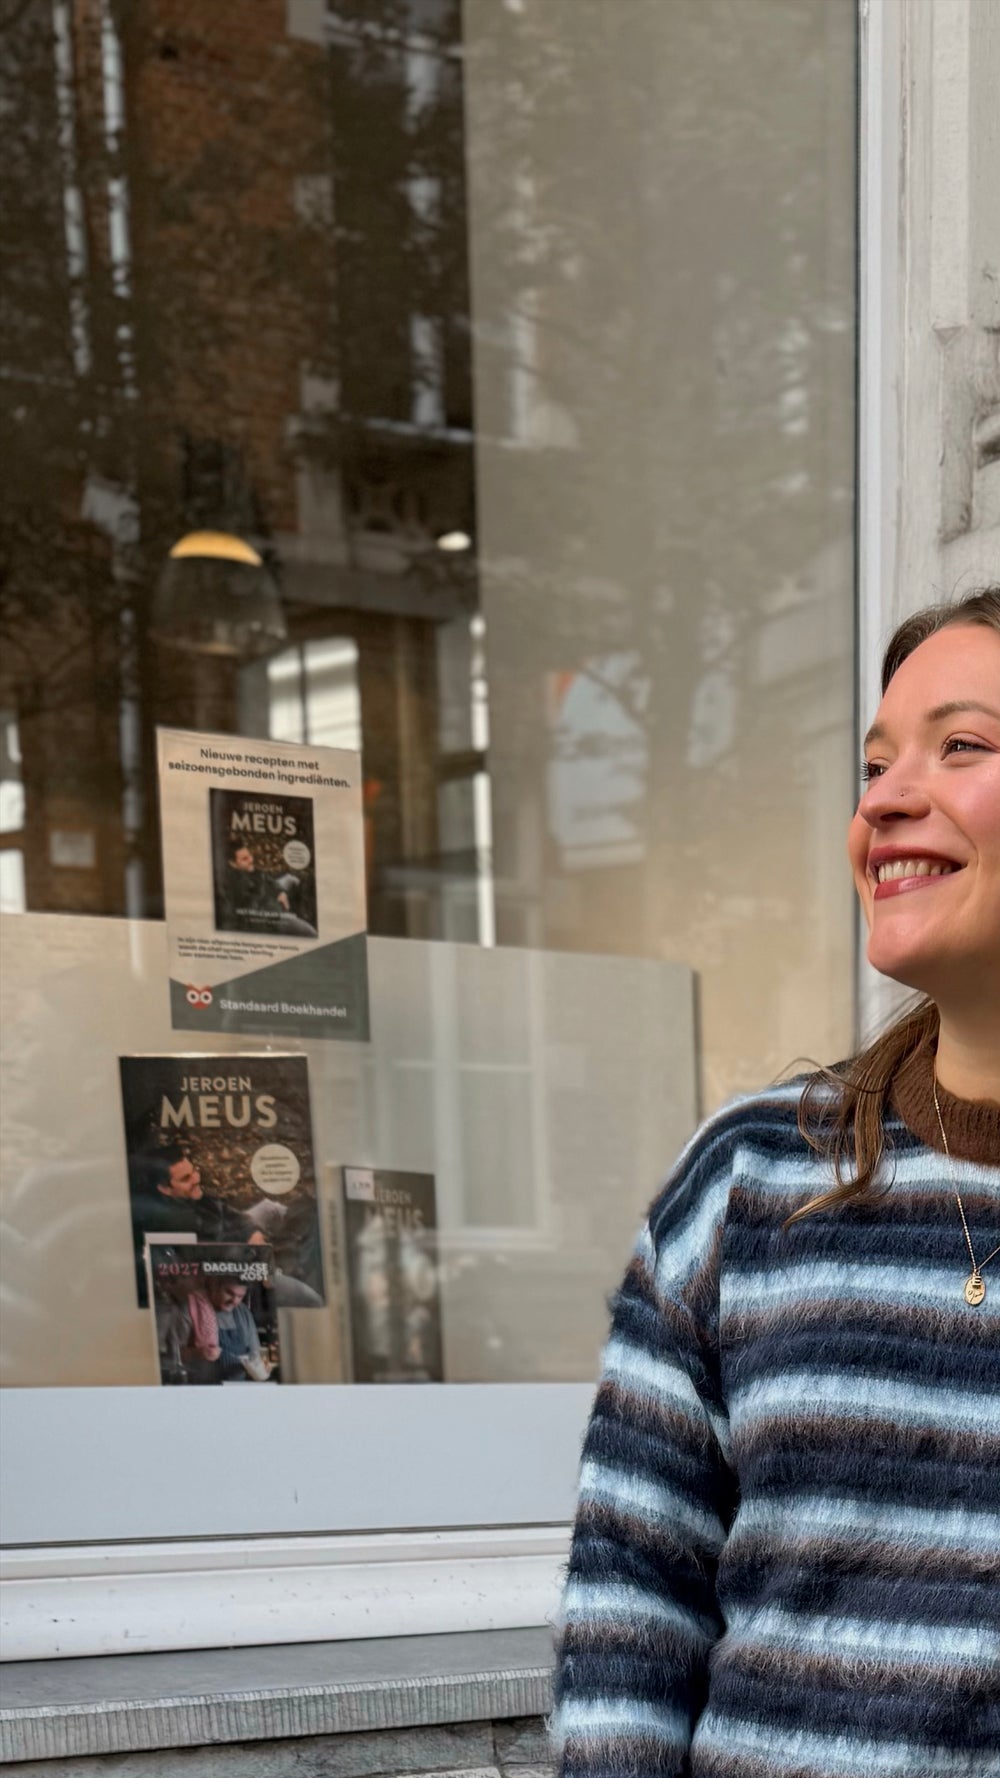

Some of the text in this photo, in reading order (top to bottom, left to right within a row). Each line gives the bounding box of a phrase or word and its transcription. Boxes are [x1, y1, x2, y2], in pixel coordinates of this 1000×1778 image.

[200, 749, 319, 770] Nieuwe recepten met
[168, 761, 351, 788] seizoensgebonden ingrediënten.
[243, 802, 284, 814] JEROEN
[231, 811, 297, 836] MEUS
[220, 999, 347, 1018] Standaard Boekhandel
[180, 1076, 252, 1092] JEROEN
[160, 1094, 278, 1128] MEUS
[158, 1262, 200, 1276] 2027
[240, 1270, 269, 1281] KOST
